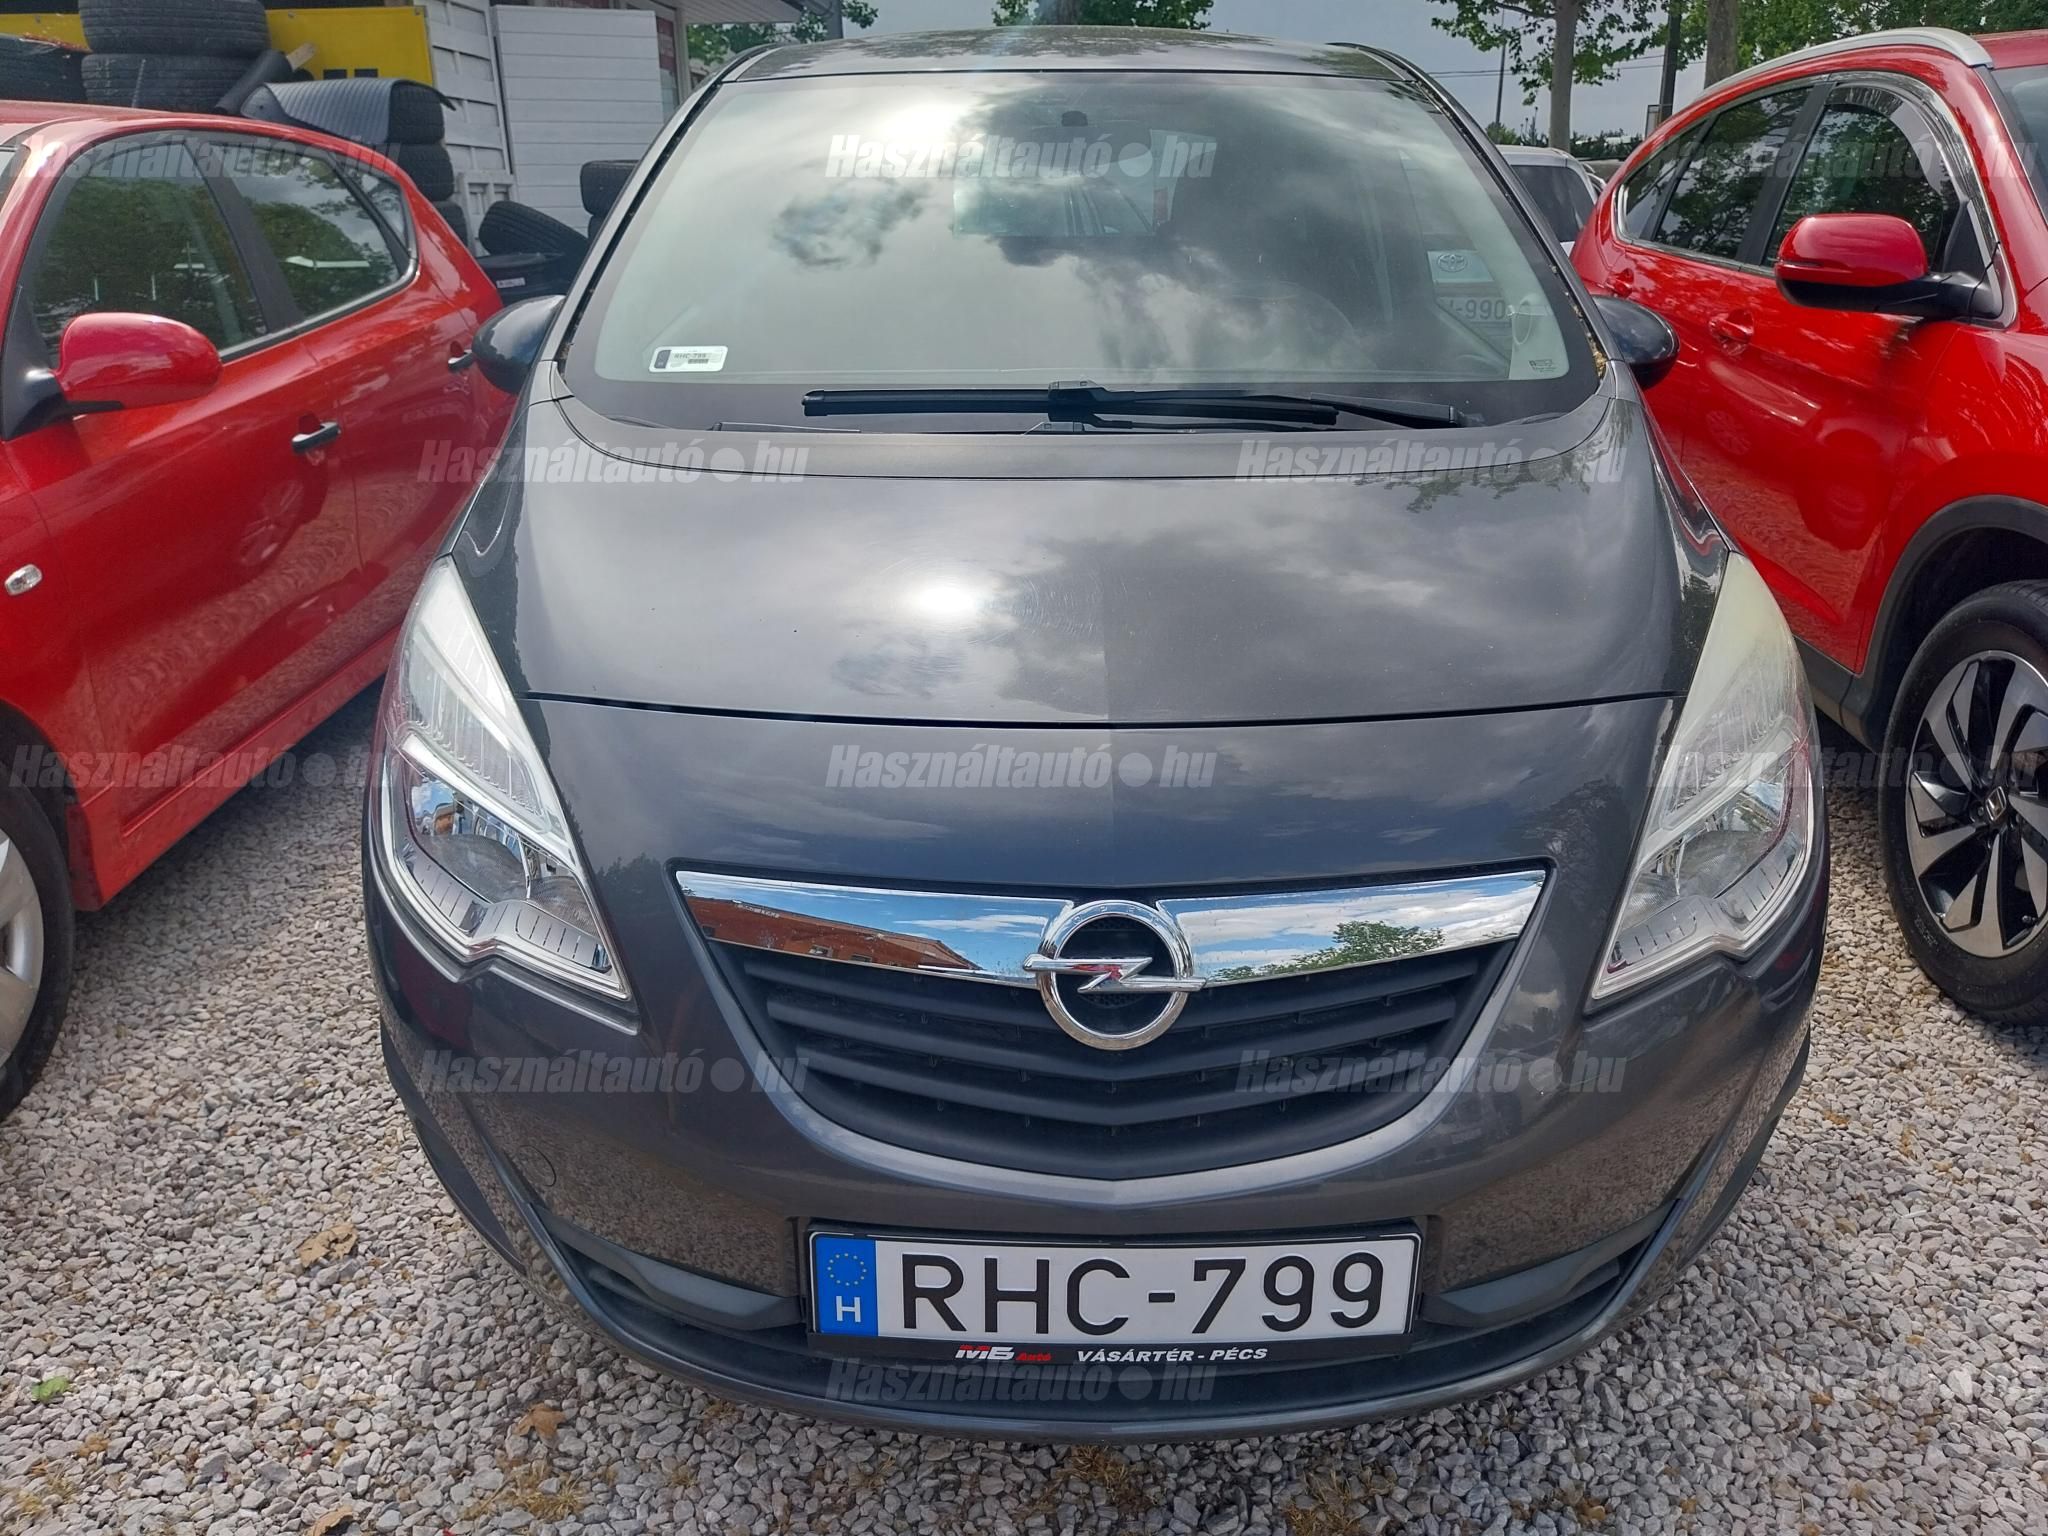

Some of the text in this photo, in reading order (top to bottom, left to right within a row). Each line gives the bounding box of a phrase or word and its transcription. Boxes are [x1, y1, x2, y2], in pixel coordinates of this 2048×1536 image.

[901, 1251, 1385, 1335] RHC-799
[835, 1295, 861, 1322] H
[1077, 1349, 1193, 1362] VÁSÁRTÉR
[1209, 1348, 1268, 1361] PÉCS
